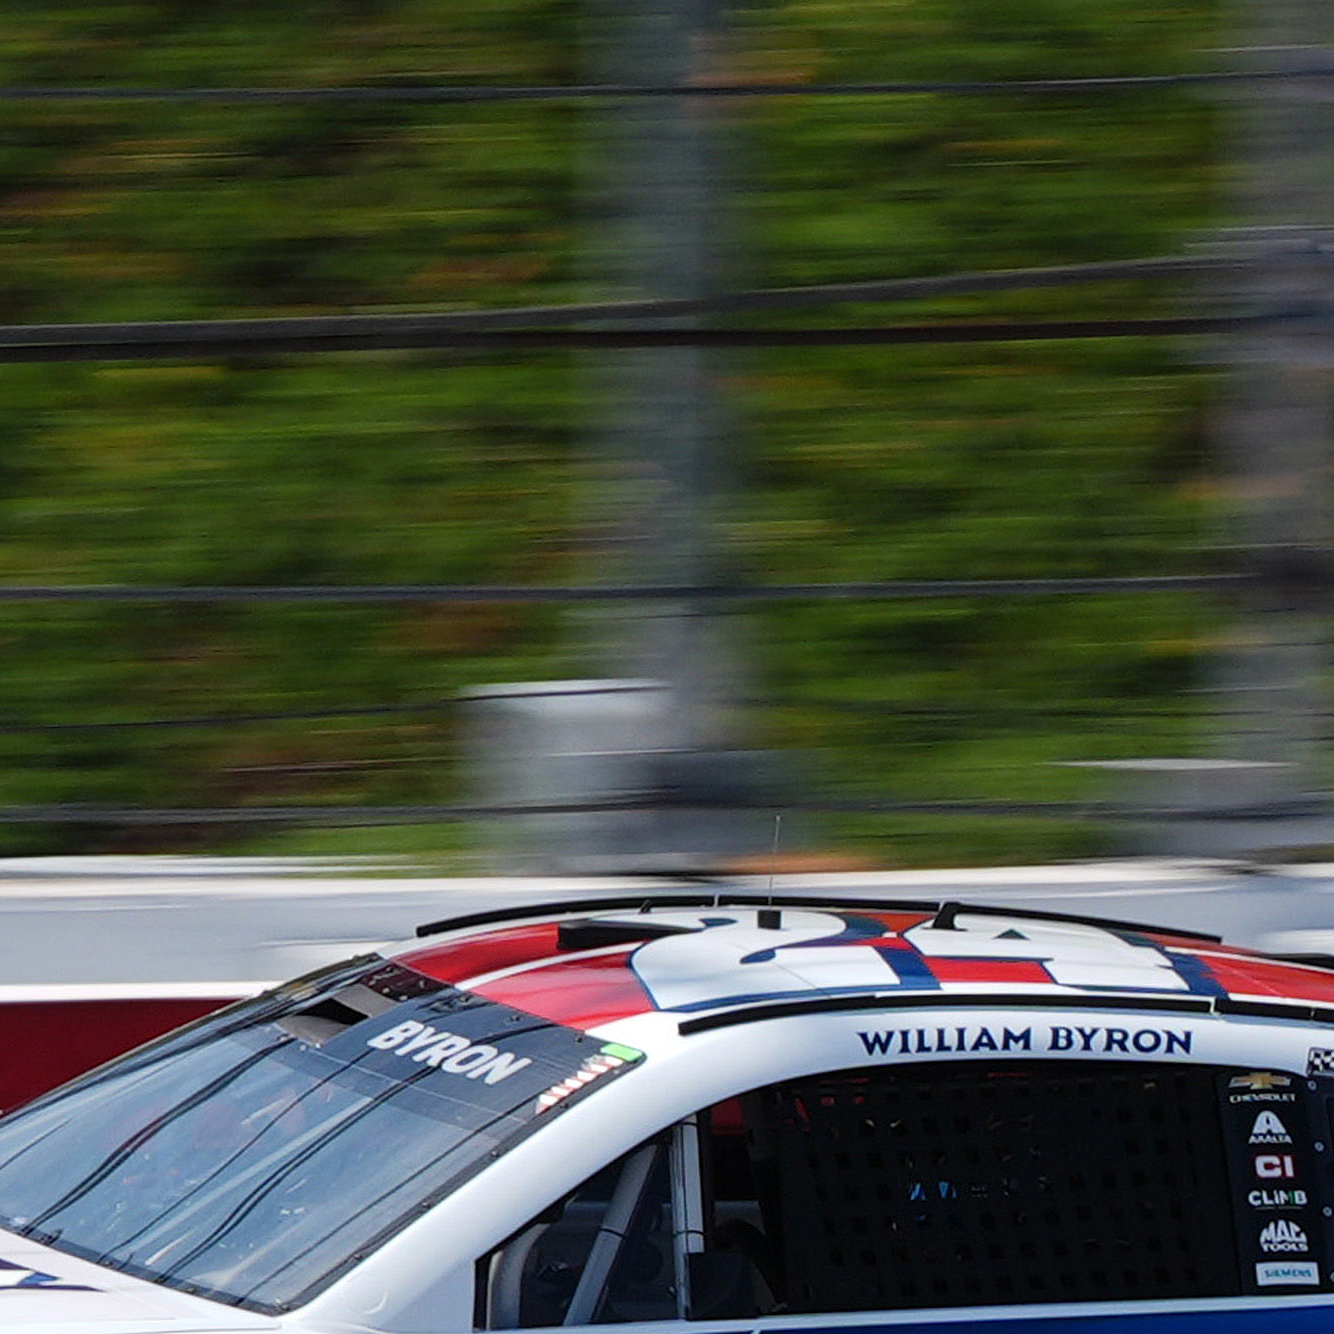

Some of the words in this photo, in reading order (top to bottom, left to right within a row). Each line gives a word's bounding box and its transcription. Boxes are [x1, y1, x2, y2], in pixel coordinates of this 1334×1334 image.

[857, 1026, 1032, 1056] WILLIAM
[1047, 1026, 1193, 1055] BYRON
[367, 1019, 533, 1086] BYRON
[1247, 1134, 1293, 1145] AXALTA
[1255, 1154, 1295, 1179] CI
[1247, 1189, 1308, 1207] CLIMB
[1259, 1219, 1308, 1244] MAC
[1262, 1242, 1309, 1252] TOOLS
[1264, 1268, 1312, 1279] SIEMENS
